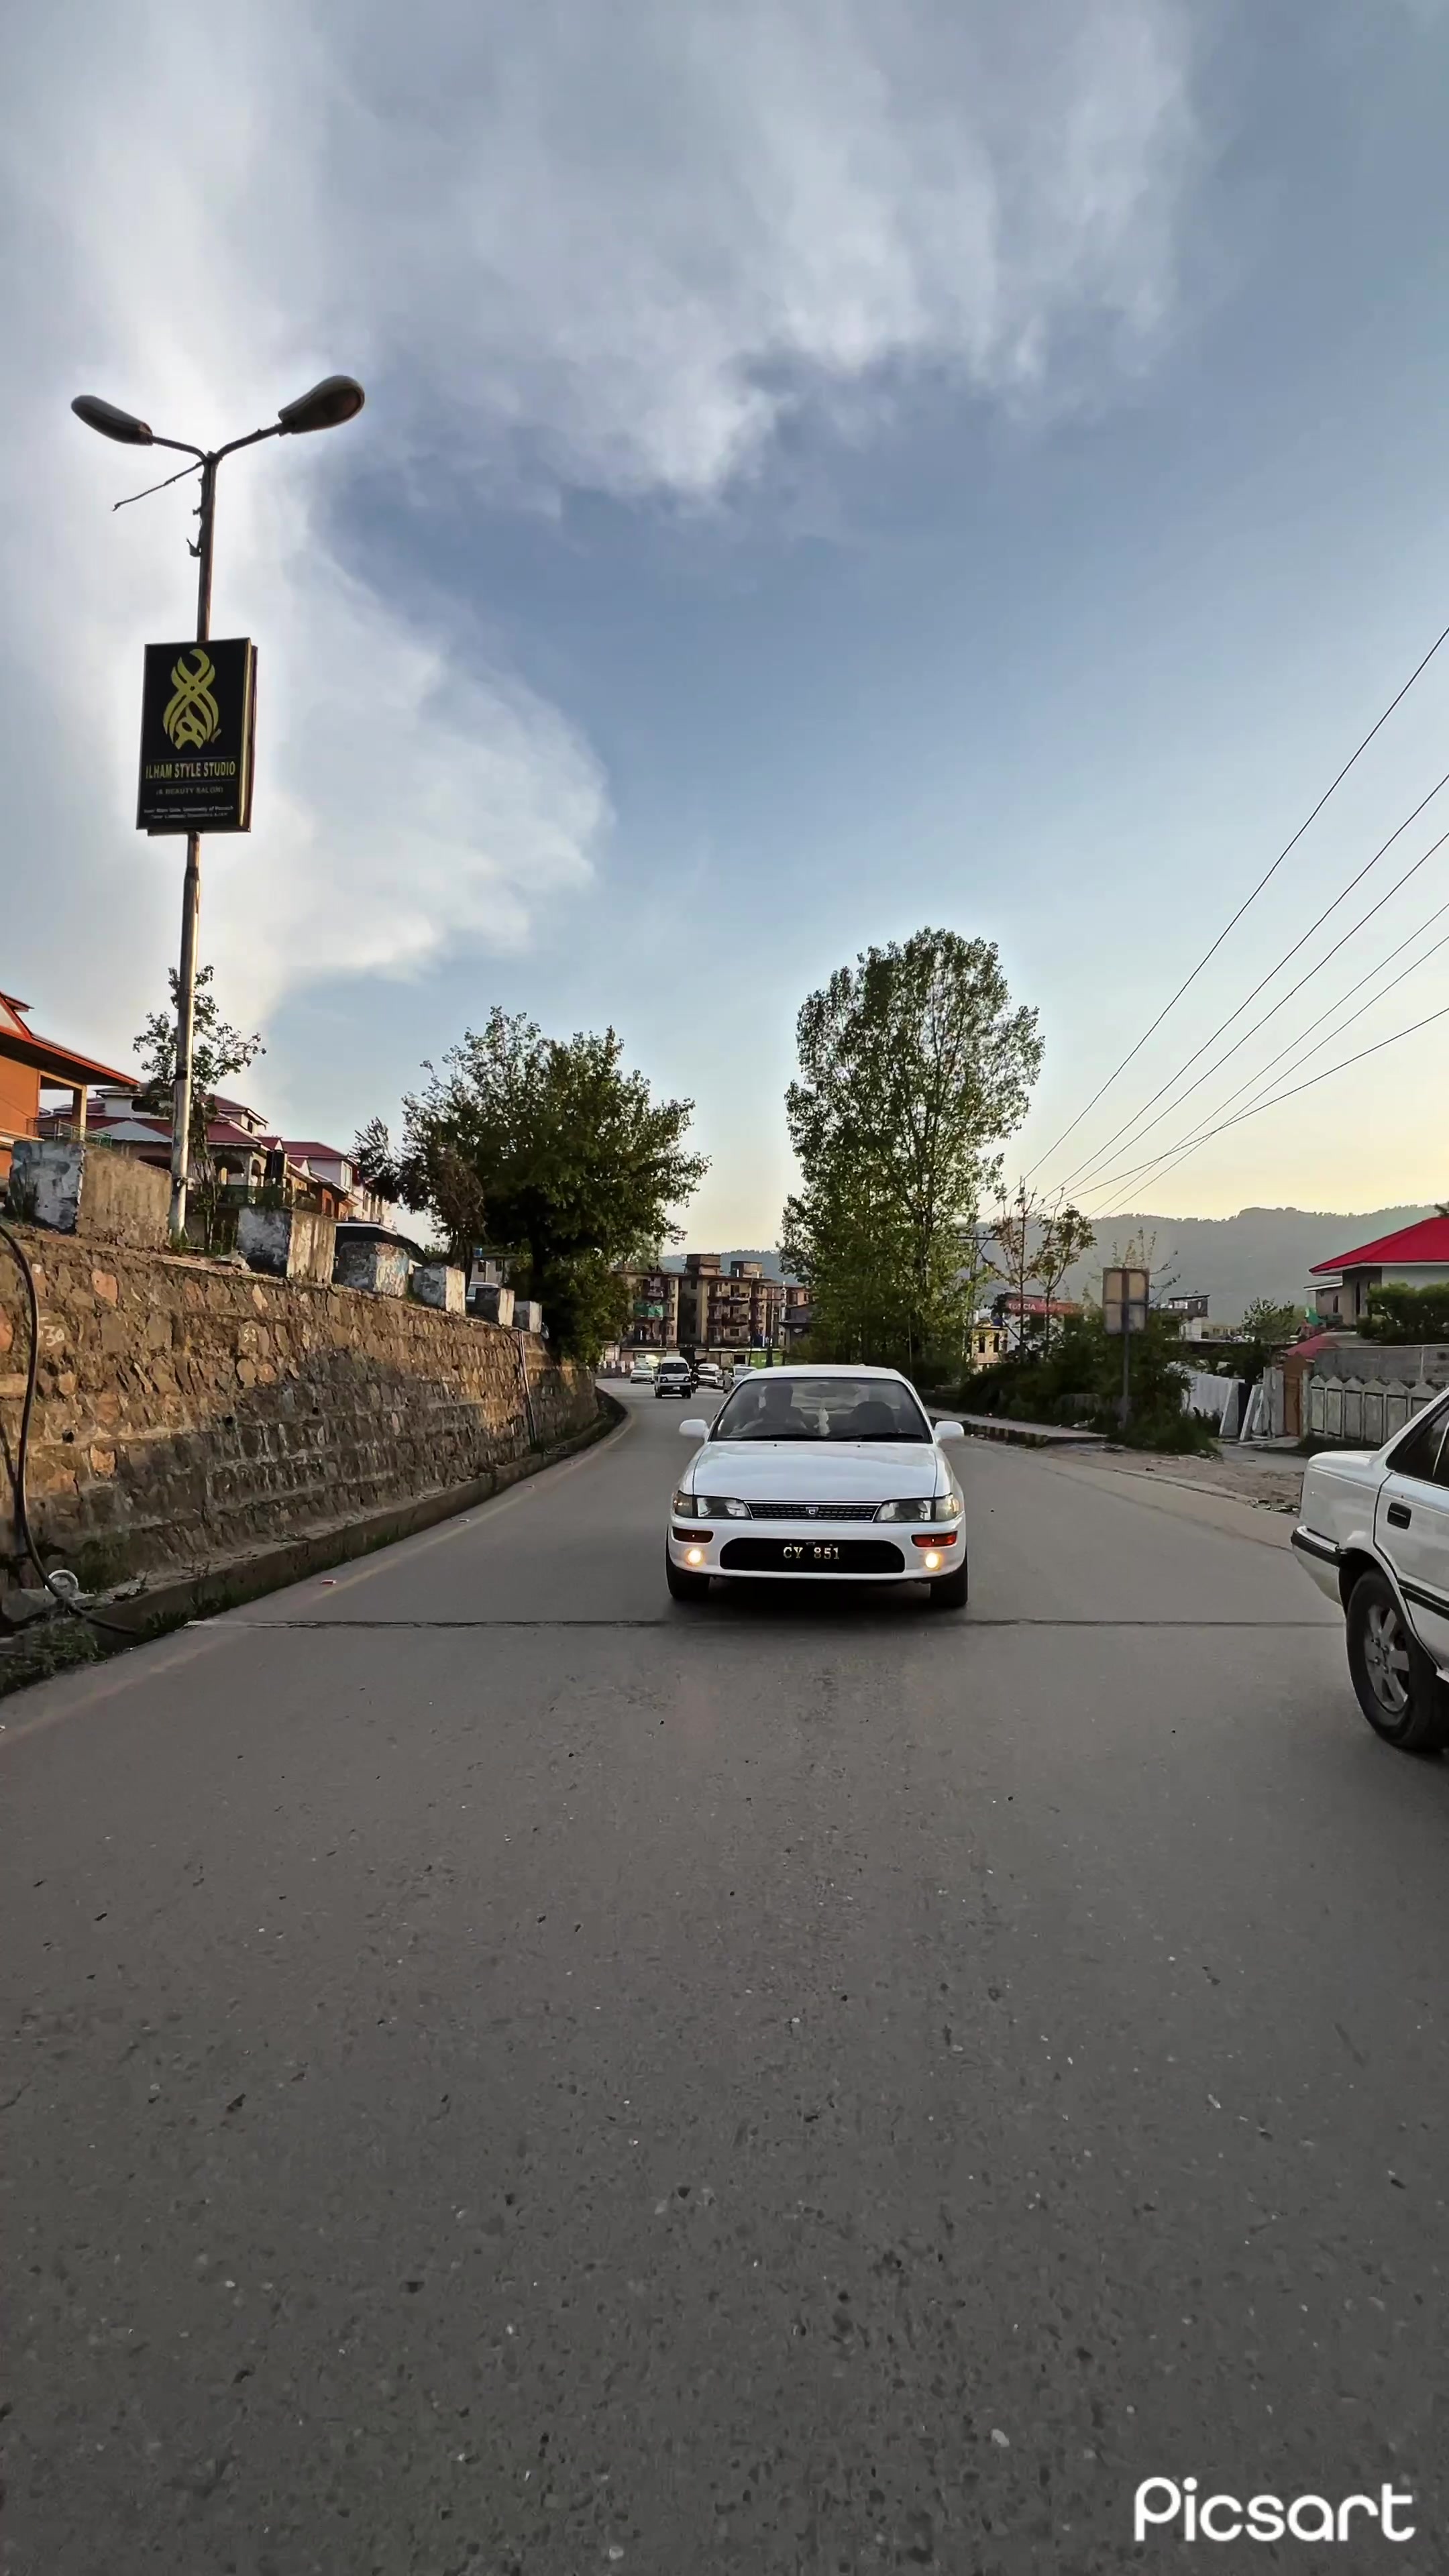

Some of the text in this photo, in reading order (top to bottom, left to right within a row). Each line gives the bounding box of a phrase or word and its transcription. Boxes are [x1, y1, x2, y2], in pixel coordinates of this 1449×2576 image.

[146, 761, 235, 779] ILHAM STYLE STUDIO
[165, 787, 194, 796] BEAUTY
[784, 1546, 839, 1560] CY 851
